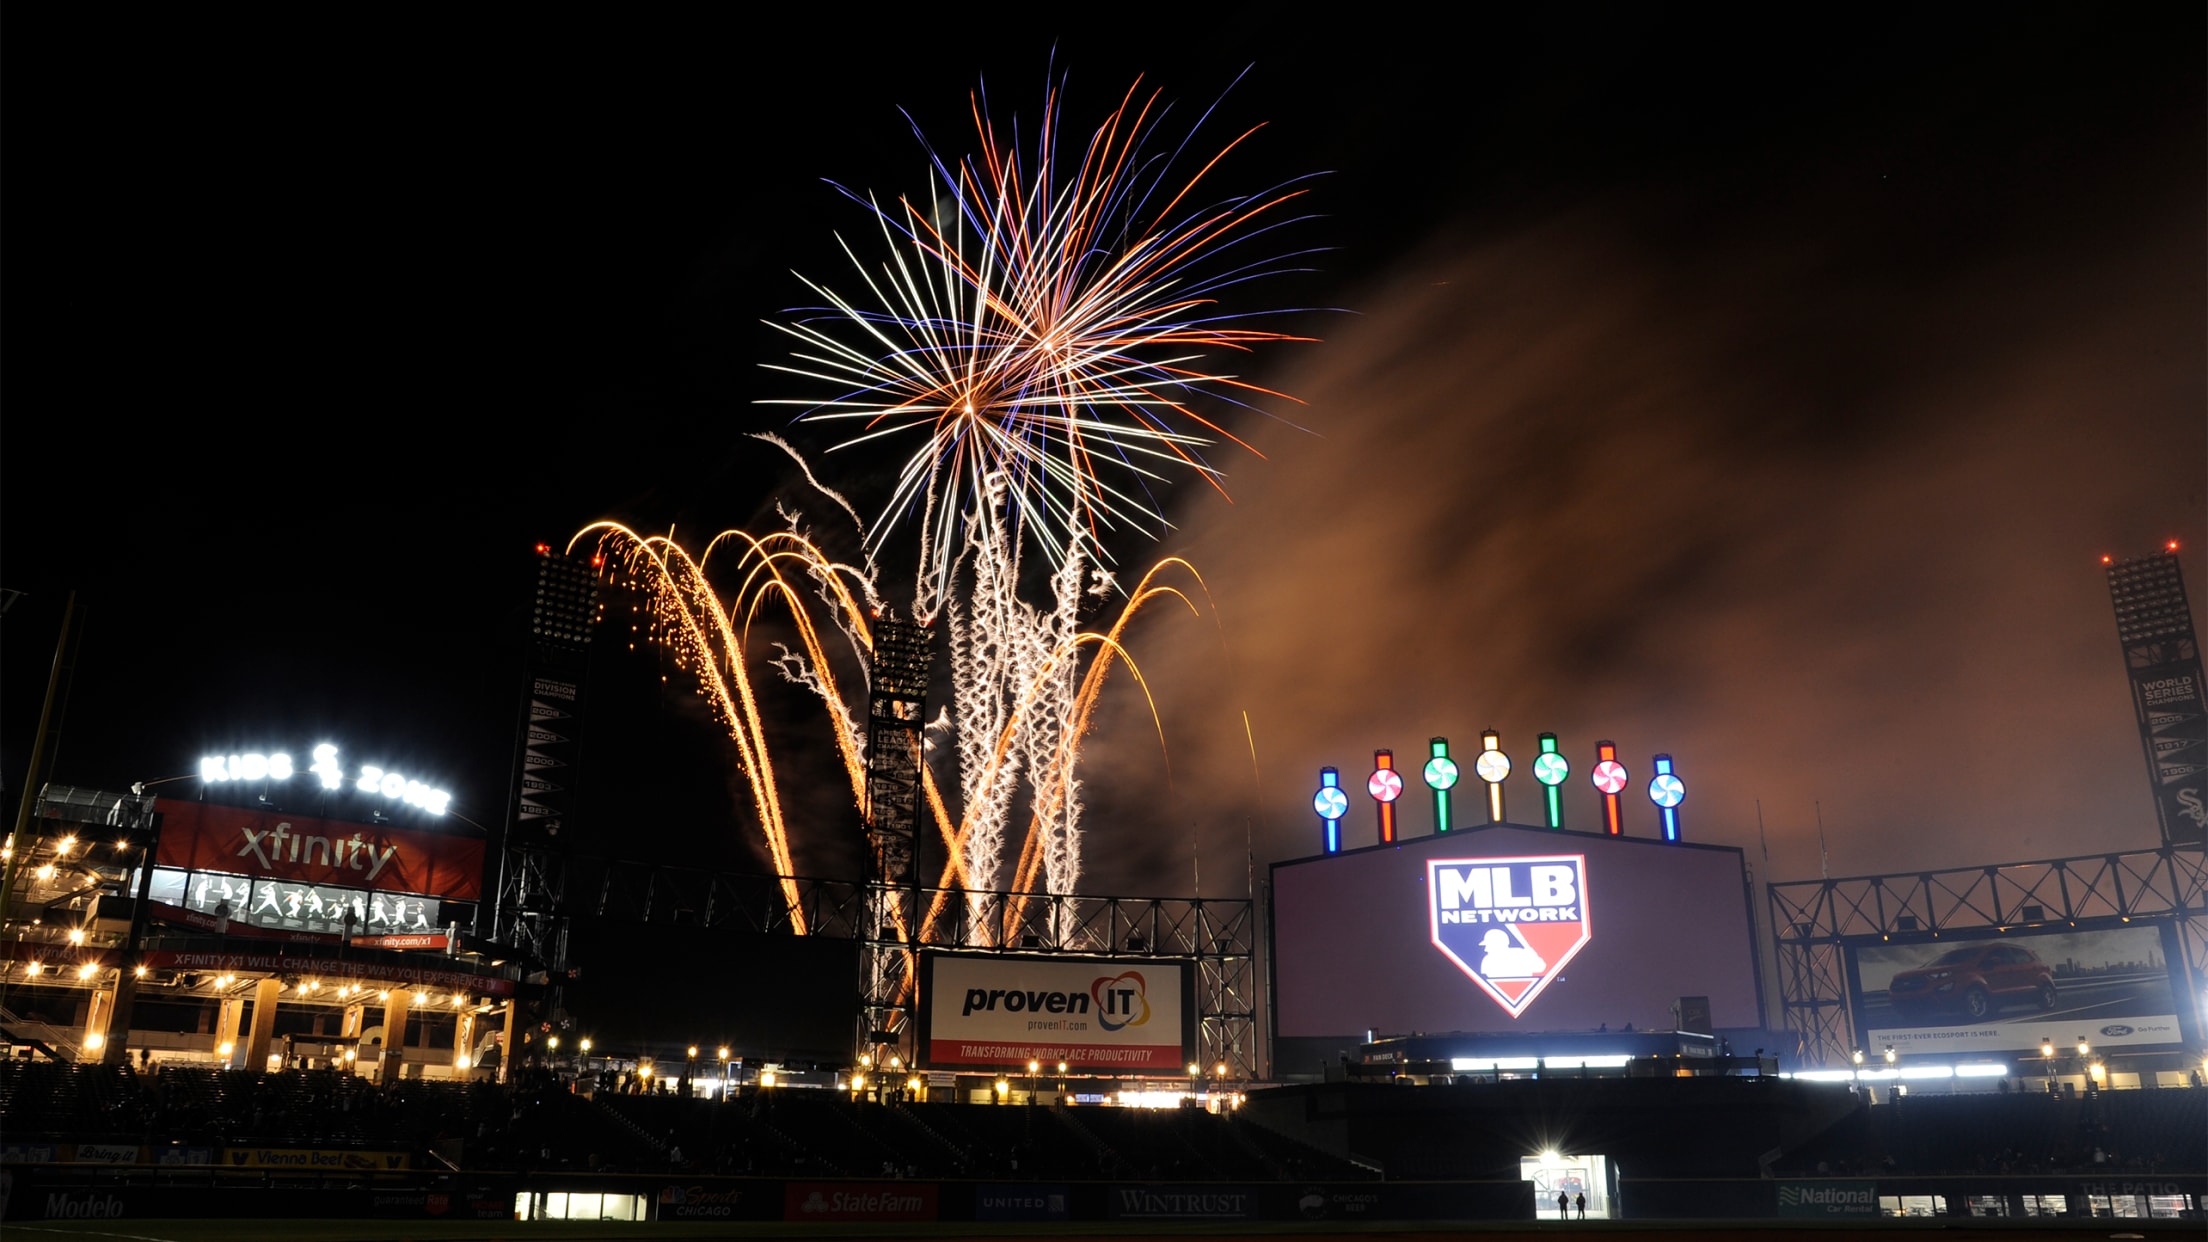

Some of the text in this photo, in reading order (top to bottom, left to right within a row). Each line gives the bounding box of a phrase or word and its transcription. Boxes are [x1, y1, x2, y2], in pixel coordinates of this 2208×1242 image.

[534, 681, 576, 696] DIVISION
[2142, 676, 2192, 690] WORLD
[533, 689, 576, 701] CHAMPIONS
[2145, 684, 2194, 700] SERIES
[200, 752, 293, 783] KIDS
[356, 765, 451, 817] ZONE
[237, 822, 397, 881] xfinity
[1439, 865, 1576, 909] MLB
[1441, 907, 1578, 924] NETWORK
[374, 937, 431, 947] xfinity.com/x1
[174, 953, 497, 990] XFINITY X1 WILL CHANGE THE WAY YOU EXPERIENCE TV
[962, 988, 1135, 1016] proven IT
[1028, 1020, 1087, 1032] provenIT.com
[1933, 1031, 1969, 1039] ECOSPORT
[961, 1045, 1152, 1062] TRANSFORMING WORKPLACE PRODUCTIVITY
[79, 1146, 120, 1164] Bring
[257, 1151, 307, 1165] Vienna
[311, 1152, 343, 1166] Beef
[1800, 1187, 1875, 1204] National
[2080, 1182, 2180, 1195] THE PATIO
[43, 1193, 125, 1219] Modelo
[983, 1197, 1045, 1208] UNITED
[1119, 1189, 1246, 1213] WINTRUST
[1827, 1204, 1873, 1213] Car Rental
[477, 1209, 504, 1218] team
[676, 1206, 732, 1217] CHICAGO
